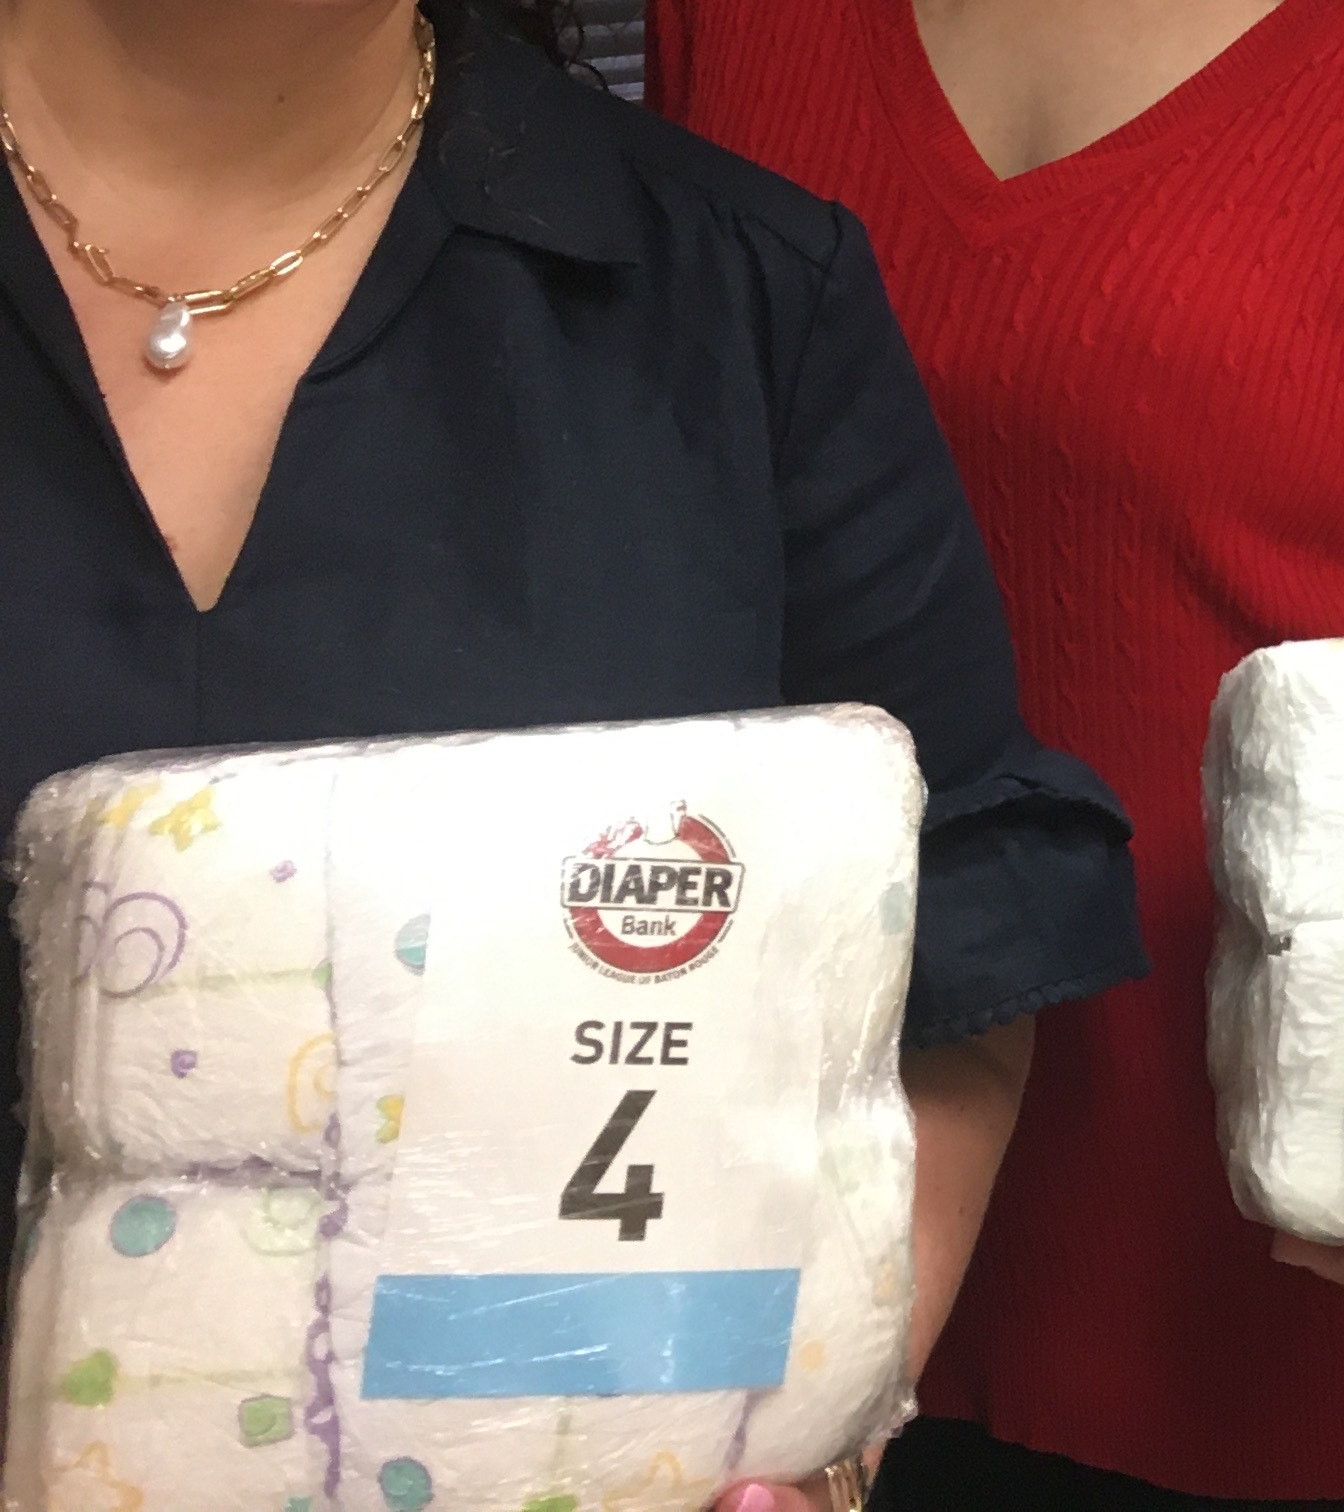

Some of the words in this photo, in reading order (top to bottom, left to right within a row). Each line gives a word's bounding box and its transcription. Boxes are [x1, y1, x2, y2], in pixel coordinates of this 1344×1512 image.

[567, 862, 734, 908] DIAPER
[620, 915, 677, 937] Bank
[570, 1020, 694, 1066] SIZE
[558, 1089, 666, 1243] 4
